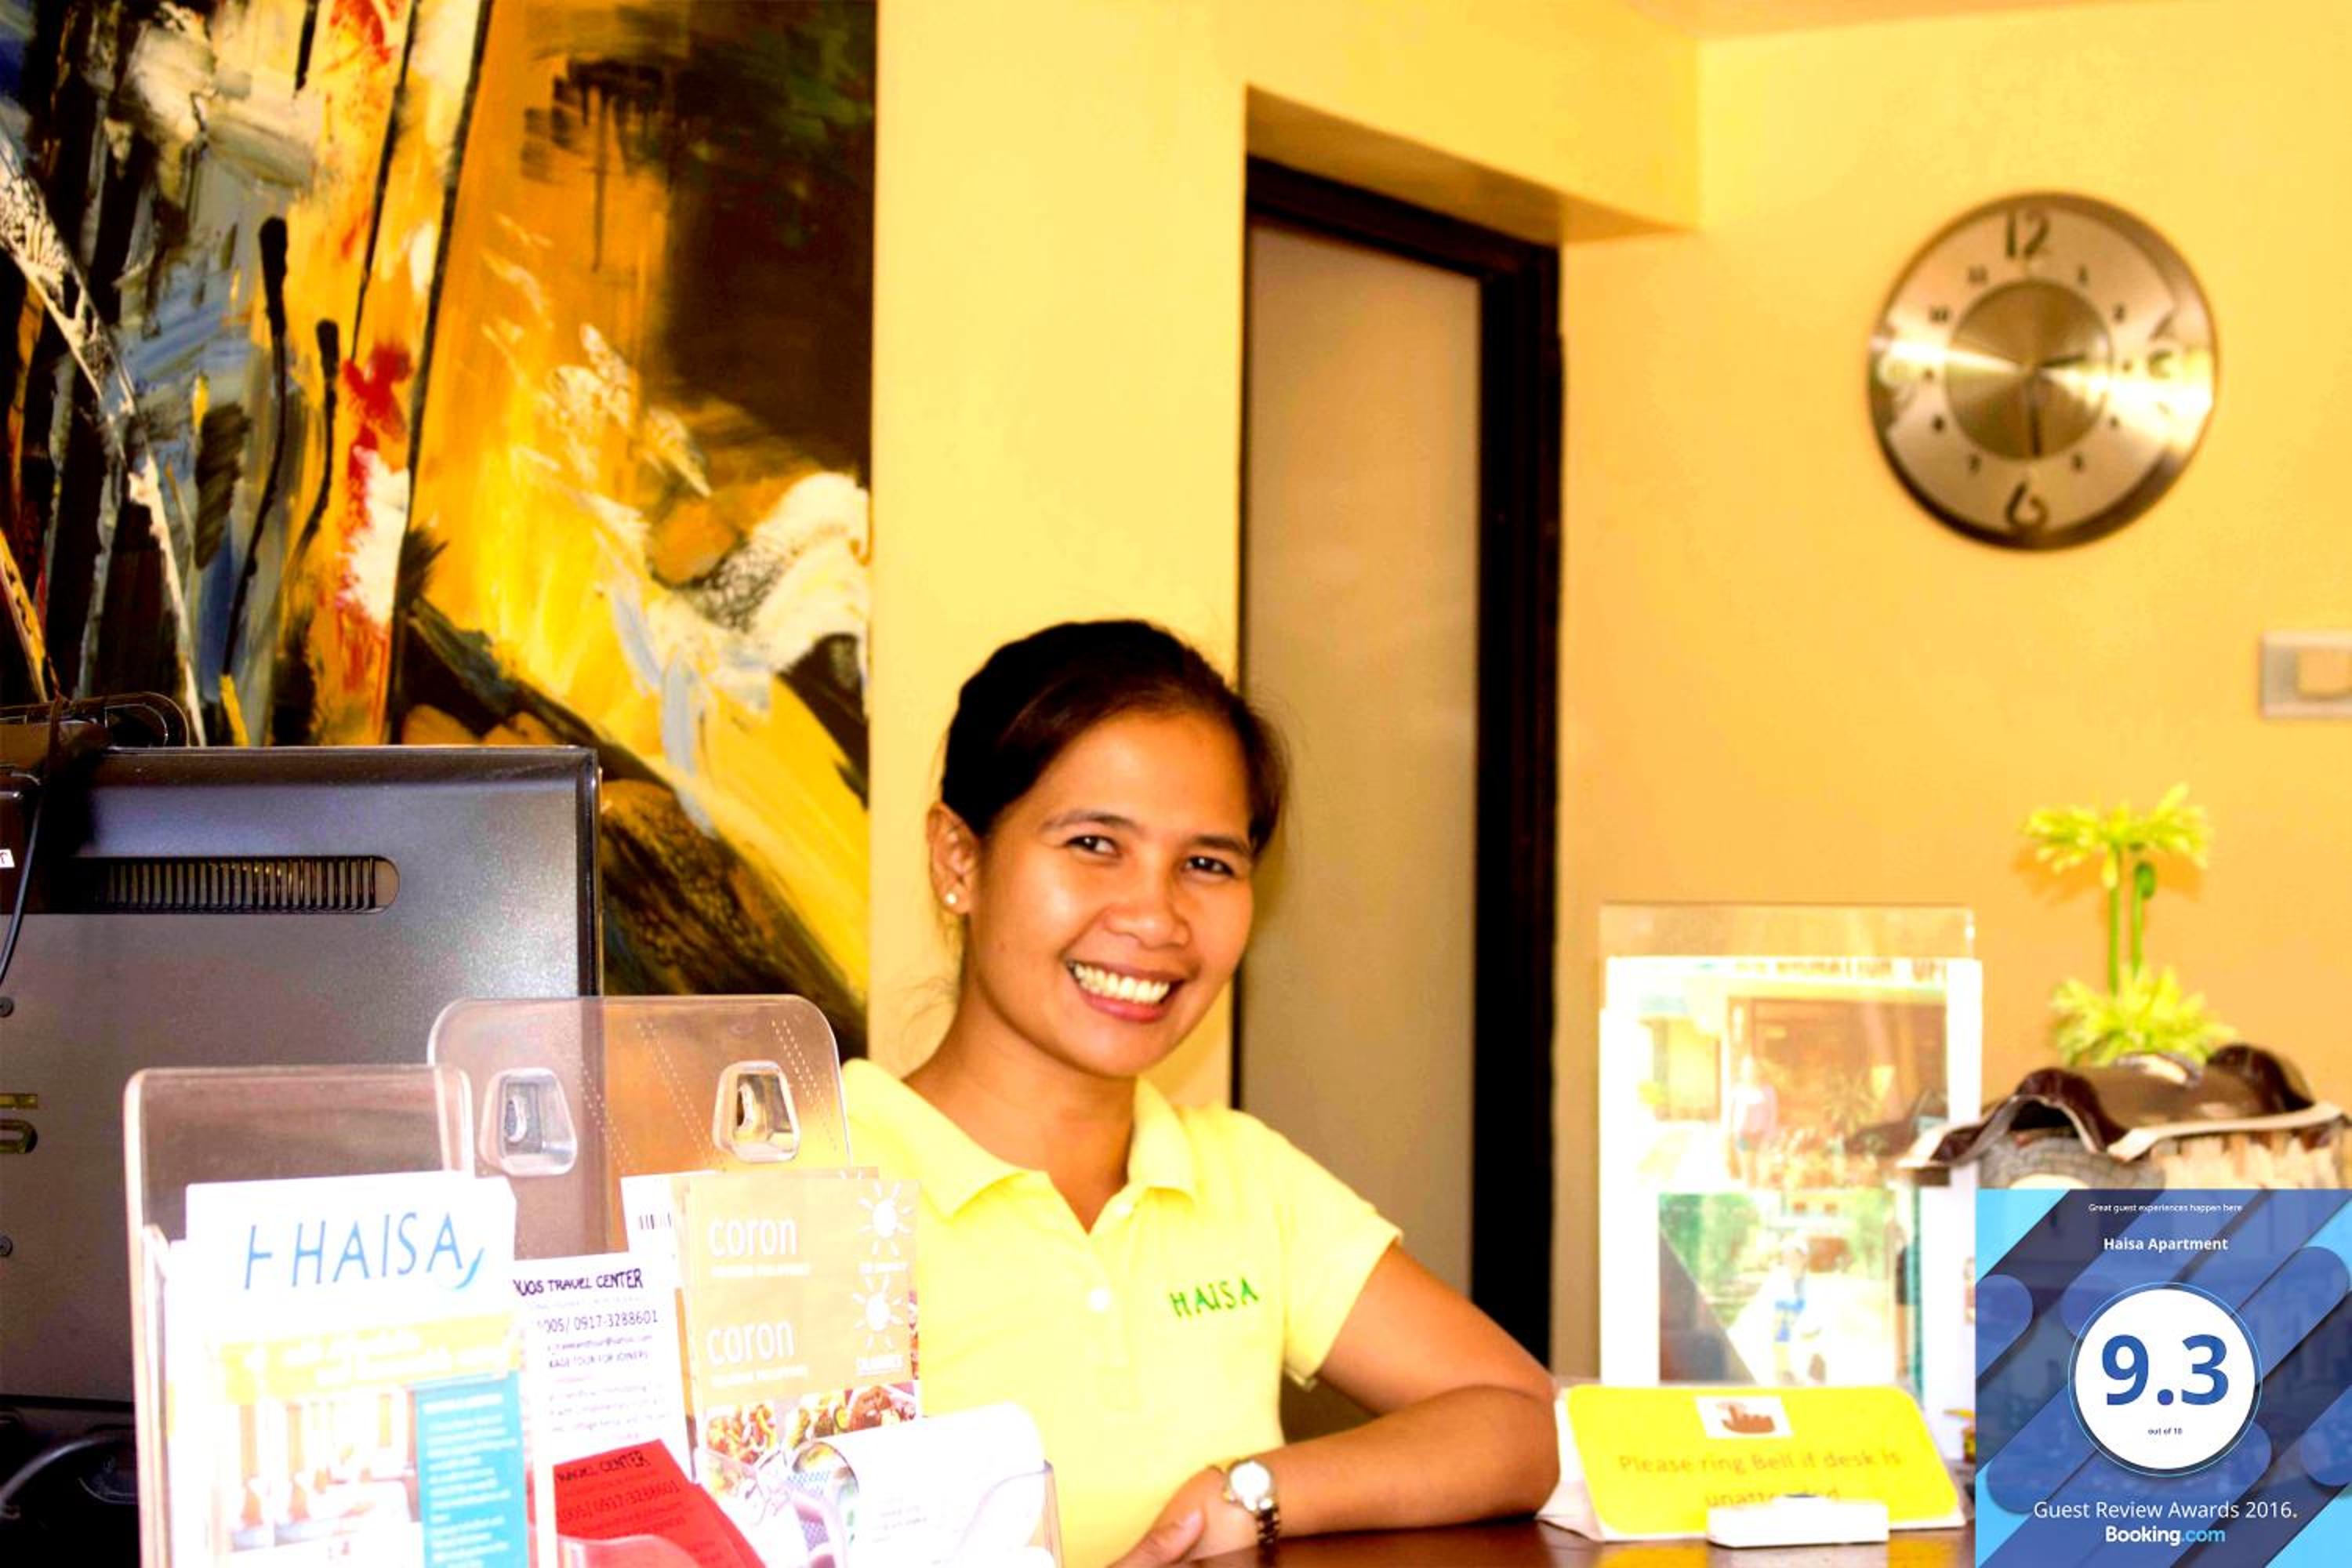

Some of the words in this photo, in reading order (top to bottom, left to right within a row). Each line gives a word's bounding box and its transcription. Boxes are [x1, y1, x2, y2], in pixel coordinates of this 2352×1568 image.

[2004, 204, 2051, 259] 12
[2004, 481, 2050, 536] 6
[707, 1217, 797, 1257] coron
[548, 1277, 592, 1291] TRAVEL
[596, 1268, 643, 1289] CENTER
[1170, 1277, 1258, 1317] HAISA
[706, 1320, 795, 1364] coron
[1617, 1454, 1693, 1473] Please
[1700, 1452, 1747, 1475] ring
[1751, 1450, 1795, 1471] Bell
[1824, 1449, 1875, 1468] desk
[1881, 1448, 1903, 1466] is
